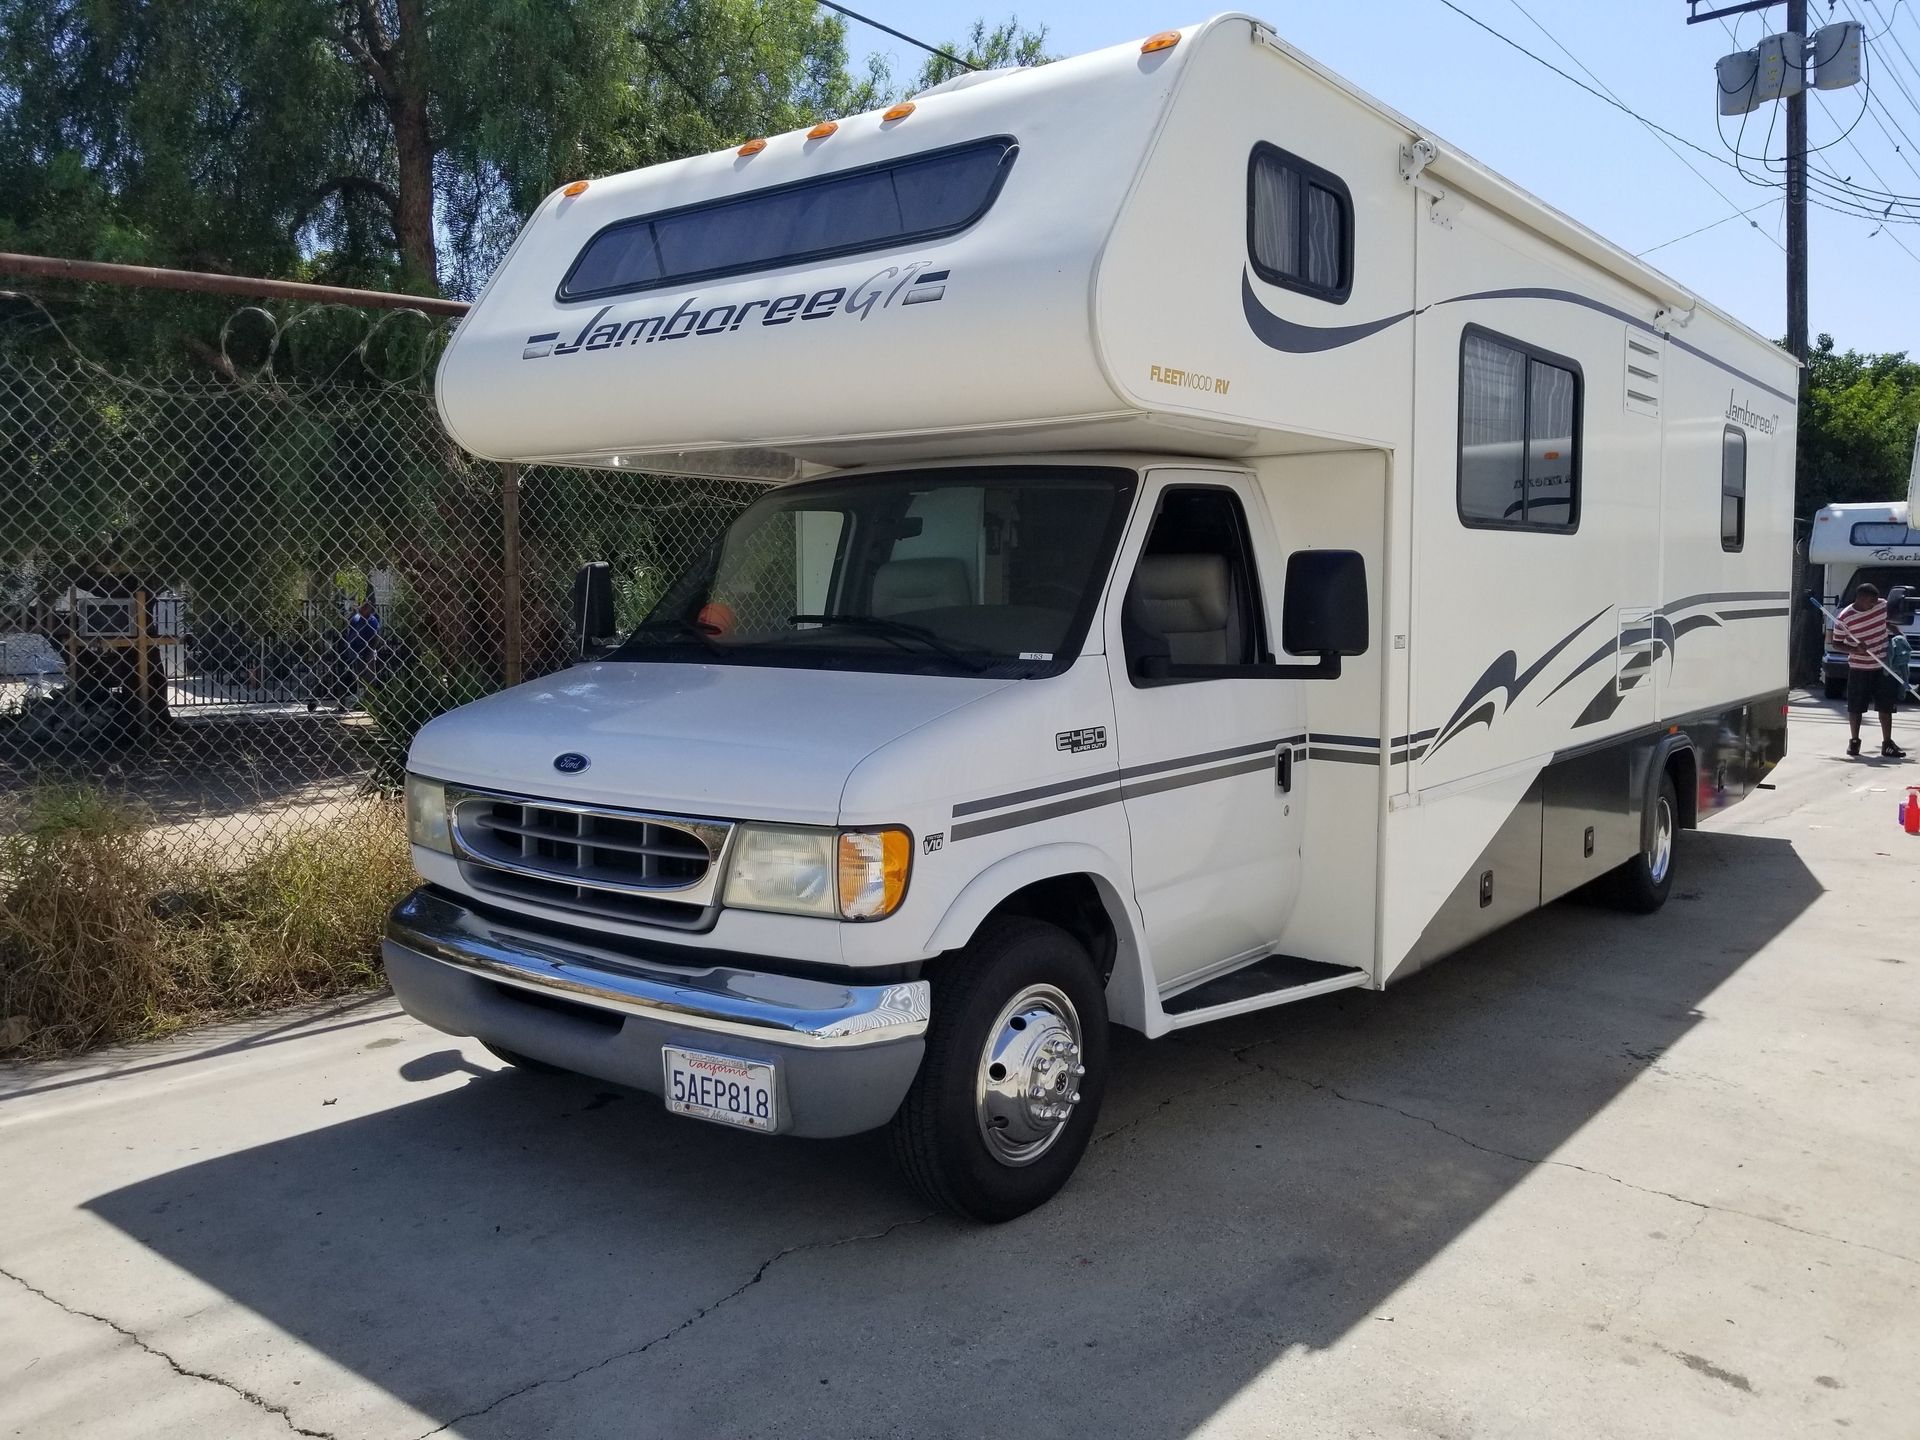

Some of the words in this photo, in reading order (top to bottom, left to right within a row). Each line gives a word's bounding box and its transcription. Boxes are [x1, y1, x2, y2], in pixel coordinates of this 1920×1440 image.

[1150, 365, 1213, 392] FLEETWOOD
[1214, 378, 1230, 395] RV
[1073, 744, 1091, 752] SUPER
[1091, 741, 1106, 749] DUTY
[560, 756, 582, 769] Ford
[923, 838, 943, 855] V10
[673, 1069, 770, 1119] 5AEP818
